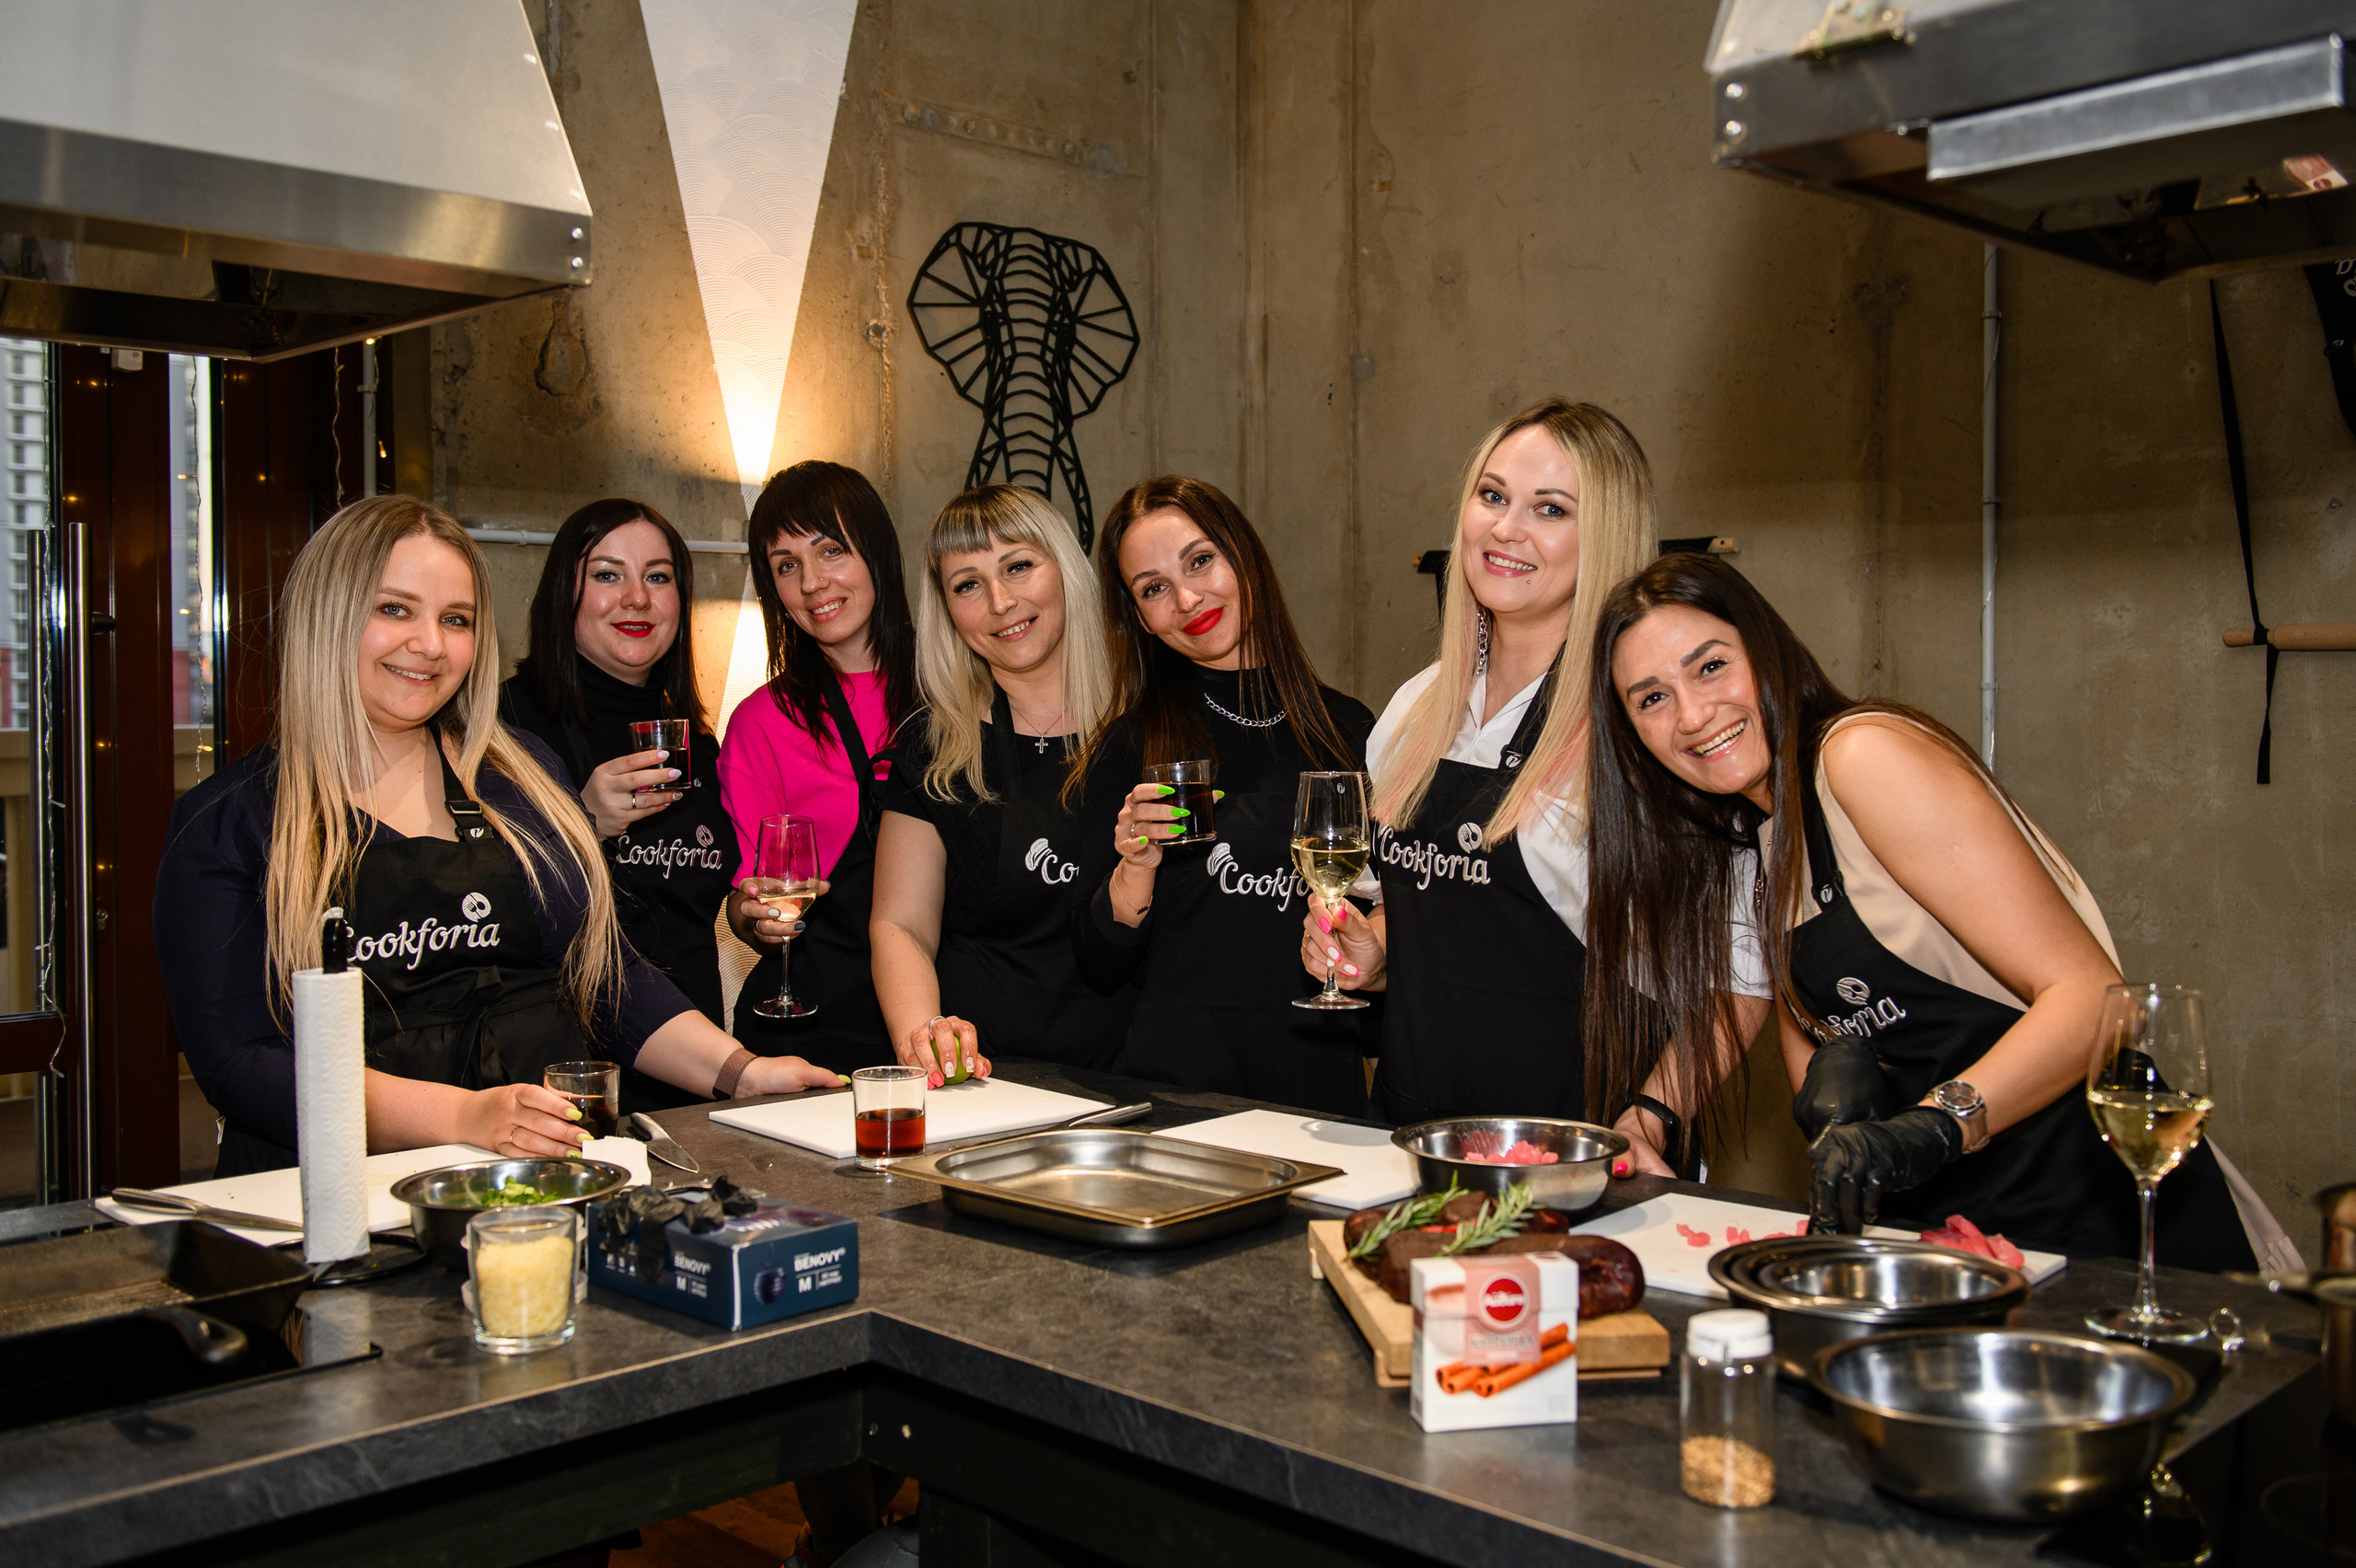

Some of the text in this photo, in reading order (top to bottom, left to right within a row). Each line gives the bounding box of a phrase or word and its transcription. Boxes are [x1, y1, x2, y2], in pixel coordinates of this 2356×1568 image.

[1041, 854, 1080, 884] Co
[1380, 826, 1491, 890] Cookforia
[1219, 861, 1311, 912] Cookfo
[676, 1275, 687, 1291] M
[799, 1276, 812, 1293] M
